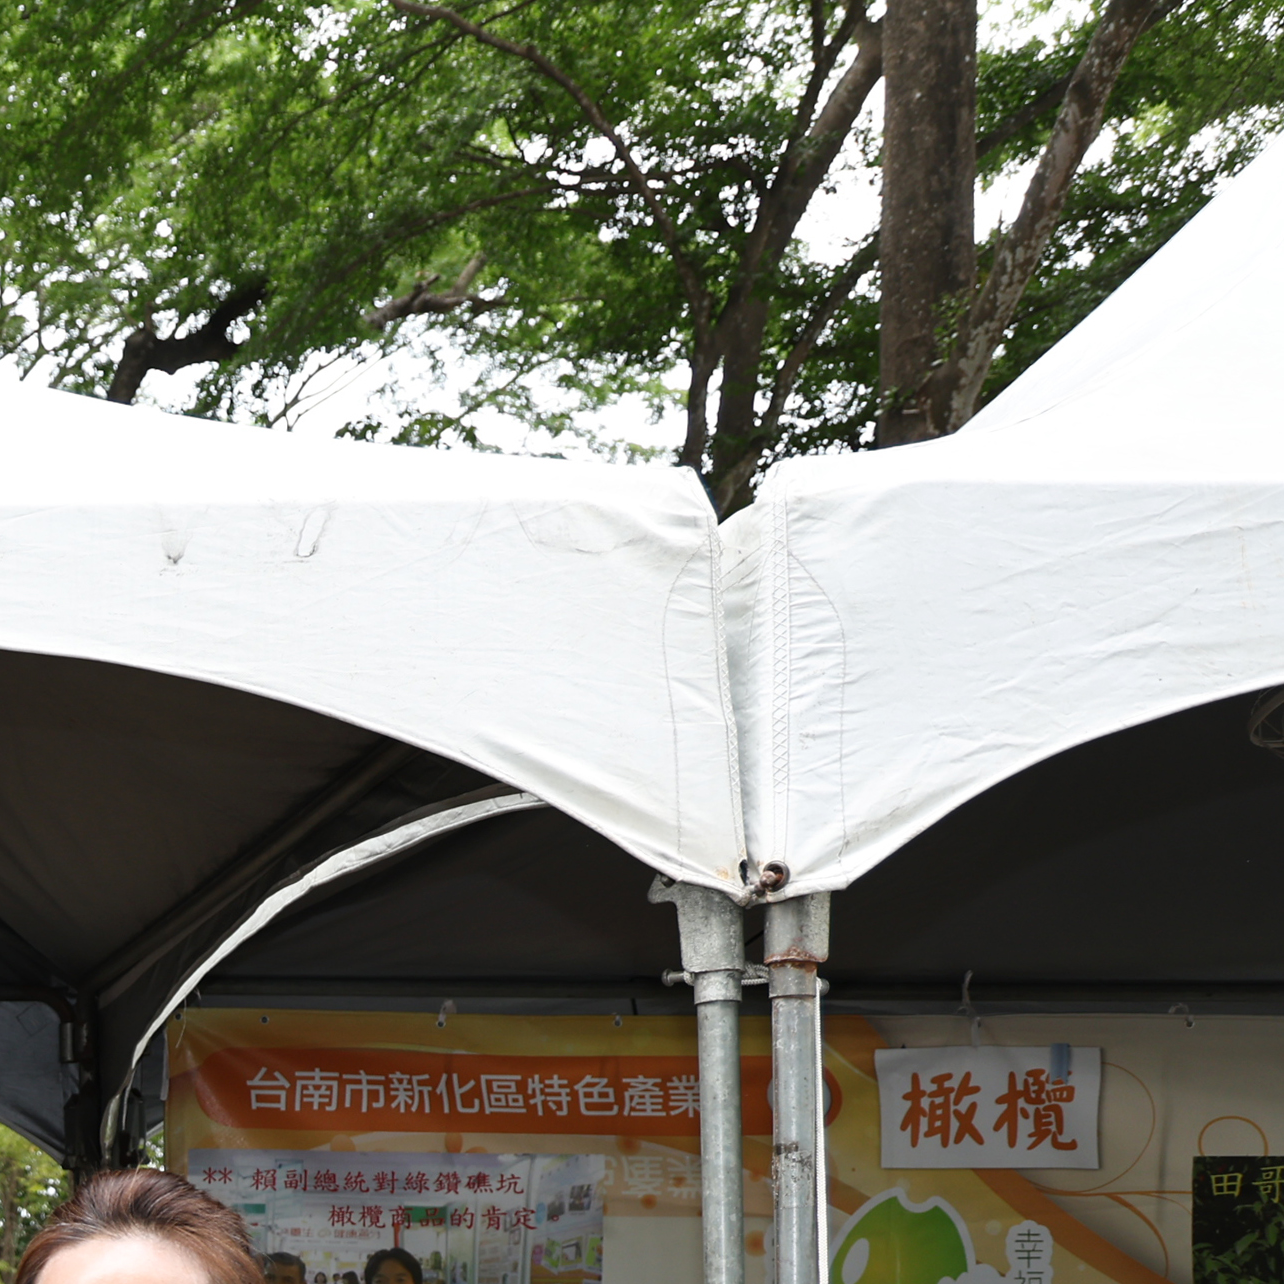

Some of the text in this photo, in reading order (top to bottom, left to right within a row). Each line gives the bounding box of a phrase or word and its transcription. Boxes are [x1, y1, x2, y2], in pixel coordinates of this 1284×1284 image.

[246, 1067, 701, 1118] 台南市新化區特色產業
[899, 1067, 1079, 1151] 橄欖
[250, 1167, 525, 1196] 賴副總統對綠鑽礁坑
